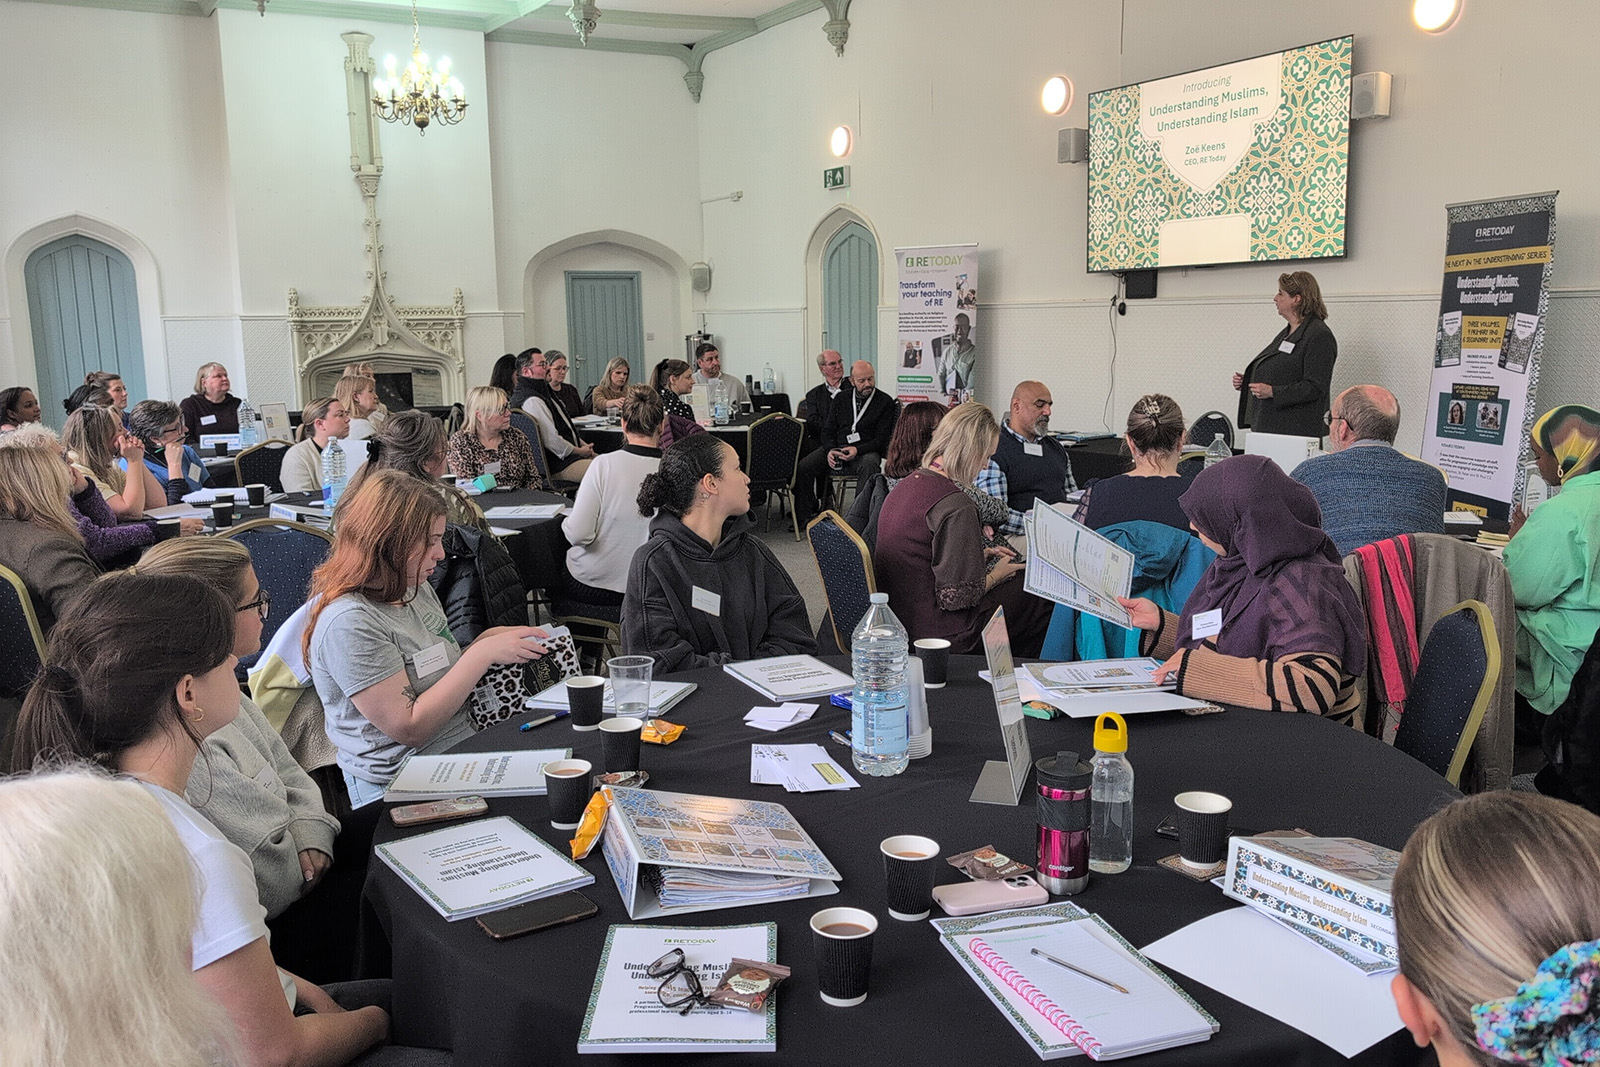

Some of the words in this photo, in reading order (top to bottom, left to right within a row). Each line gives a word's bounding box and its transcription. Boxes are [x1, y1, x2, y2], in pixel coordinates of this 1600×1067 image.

[1183, 76, 1231, 93] Introducing
[1150, 95, 1219, 116] Understanding
[1222, 87, 1268, 103] Muslims,
[1158, 112, 1228, 132] Understanding
[1230, 106, 1258, 119] Islam
[1185, 145, 1199, 154] Zoë
[1202, 142, 1225, 152] Keens
[1482, 225, 1515, 236] RETODAY
[1527, 251, 1547, 260] SERIES
[900, 280, 935, 289] Transform
[1457, 275, 1496, 290] Understanding
[902, 291, 918, 299] your
[920, 289, 952, 298] teaching
[1460, 291, 1499, 306] Understanding
[1499, 290, 1514, 302] Islam
[465, 850, 528, 869] Understanding
[478, 853, 542, 873] Understanding
[440, 866, 464, 876] Islam
[1252, 871, 1288, 895] Understanding
[1313, 896, 1352, 922] Understanding
[1352, 910, 1368, 926] Islam
[724, 997, 750, 1007] Walkers
